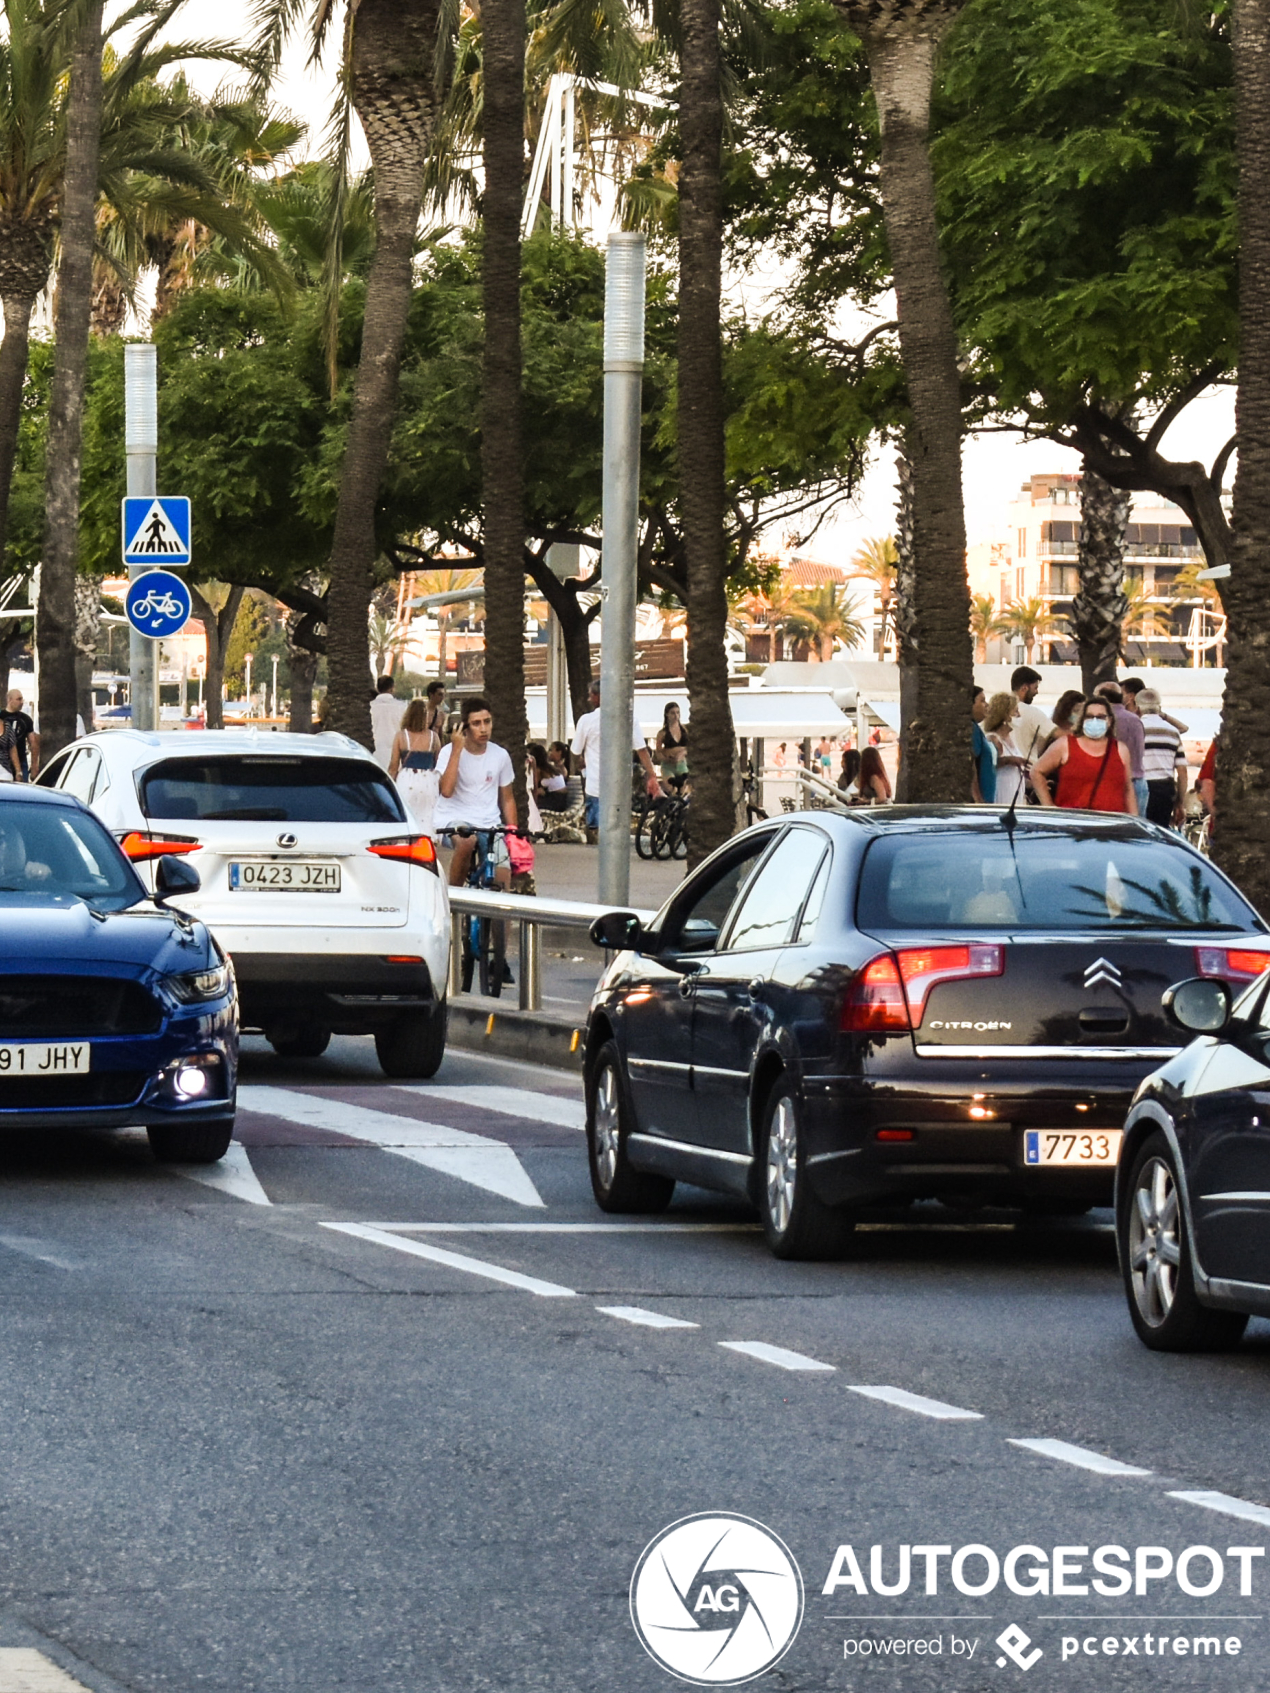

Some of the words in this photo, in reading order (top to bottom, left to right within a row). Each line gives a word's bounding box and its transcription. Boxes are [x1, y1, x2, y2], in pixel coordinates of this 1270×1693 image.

[243, 865, 293, 884] 0423
[301, 866, 336, 885] JZH
[929, 1020, 1012, 1032] CITROËN
[38, 1046, 83, 1069] JHY
[1029, 1150, 1036, 1159] E
[1046, 1134, 1110, 1160] 7733
